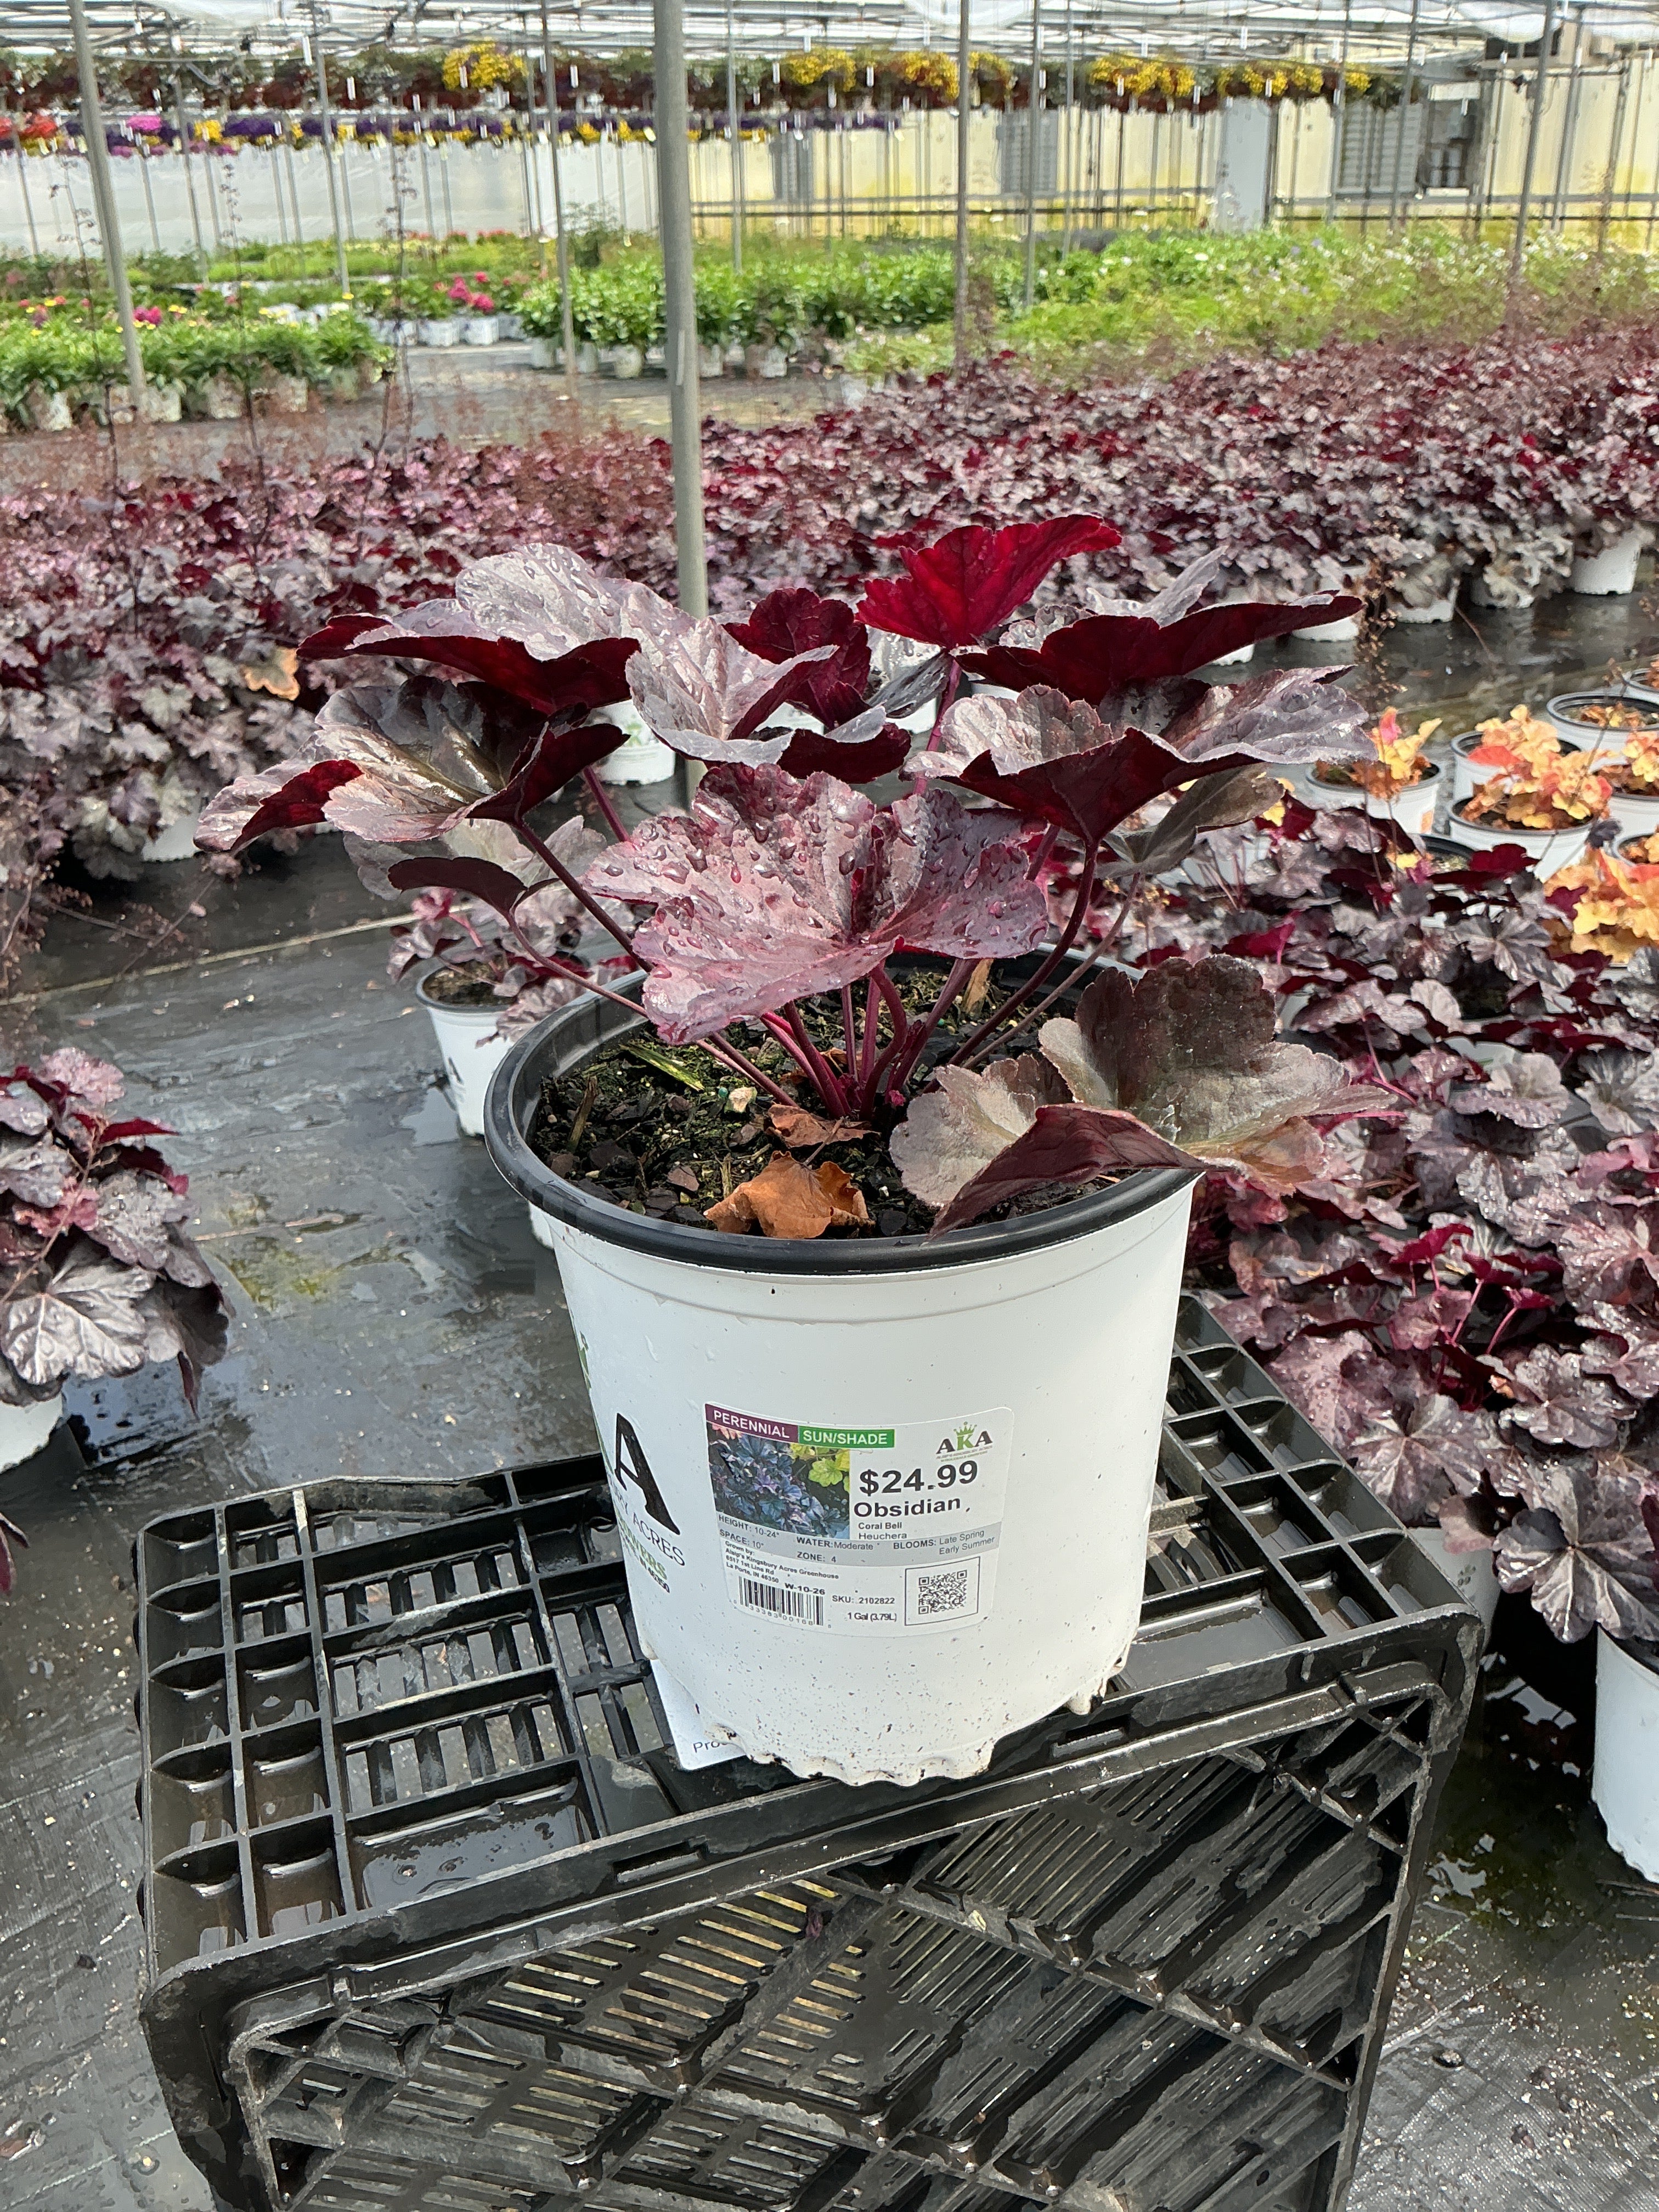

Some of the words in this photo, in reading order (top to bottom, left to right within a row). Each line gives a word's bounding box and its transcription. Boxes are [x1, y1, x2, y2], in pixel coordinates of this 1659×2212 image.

[714, 1409, 790, 1439] PERENNIAL
[803, 1430, 888, 1445] SUN/SHADE
[935, 1430, 993, 1454] AKA
[859, 1460, 978, 1497] $24.99
[719, 1514, 752, 1532] HEIGHT:
[633, 1512, 685, 1566] ACRES
[719, 1529, 750, 1546] SPACE:
[834, 1541, 874, 1550] Moderate
[893, 1539, 936, 1550] BLOOMS:
[939, 1536, 957, 1545] Late
[960, 1530, 985, 1542] Spring
[939, 1545, 960, 1555] Early
[962, 1537, 996, 1550] Summer
[725, 1541, 744, 1553] Grown
[797, 1551, 826, 1562] ZONE:
[746, 1555, 777, 1570] Kingsbury
[779, 1565, 798, 1573] Acres
[799, 1568, 839, 1579] Greenhouse
[761, 1573, 779, 1583] 46350
[785, 1582, 826, 1595] W-10-26
[832, 1595, 855, 1604] SKU:
[847, 1612, 852, 1620] 1
[854, 1612, 868, 1621] Gal
[870, 1612, 898, 1622] (3.79L)
[693, 1740, 729, 1753] Pro
